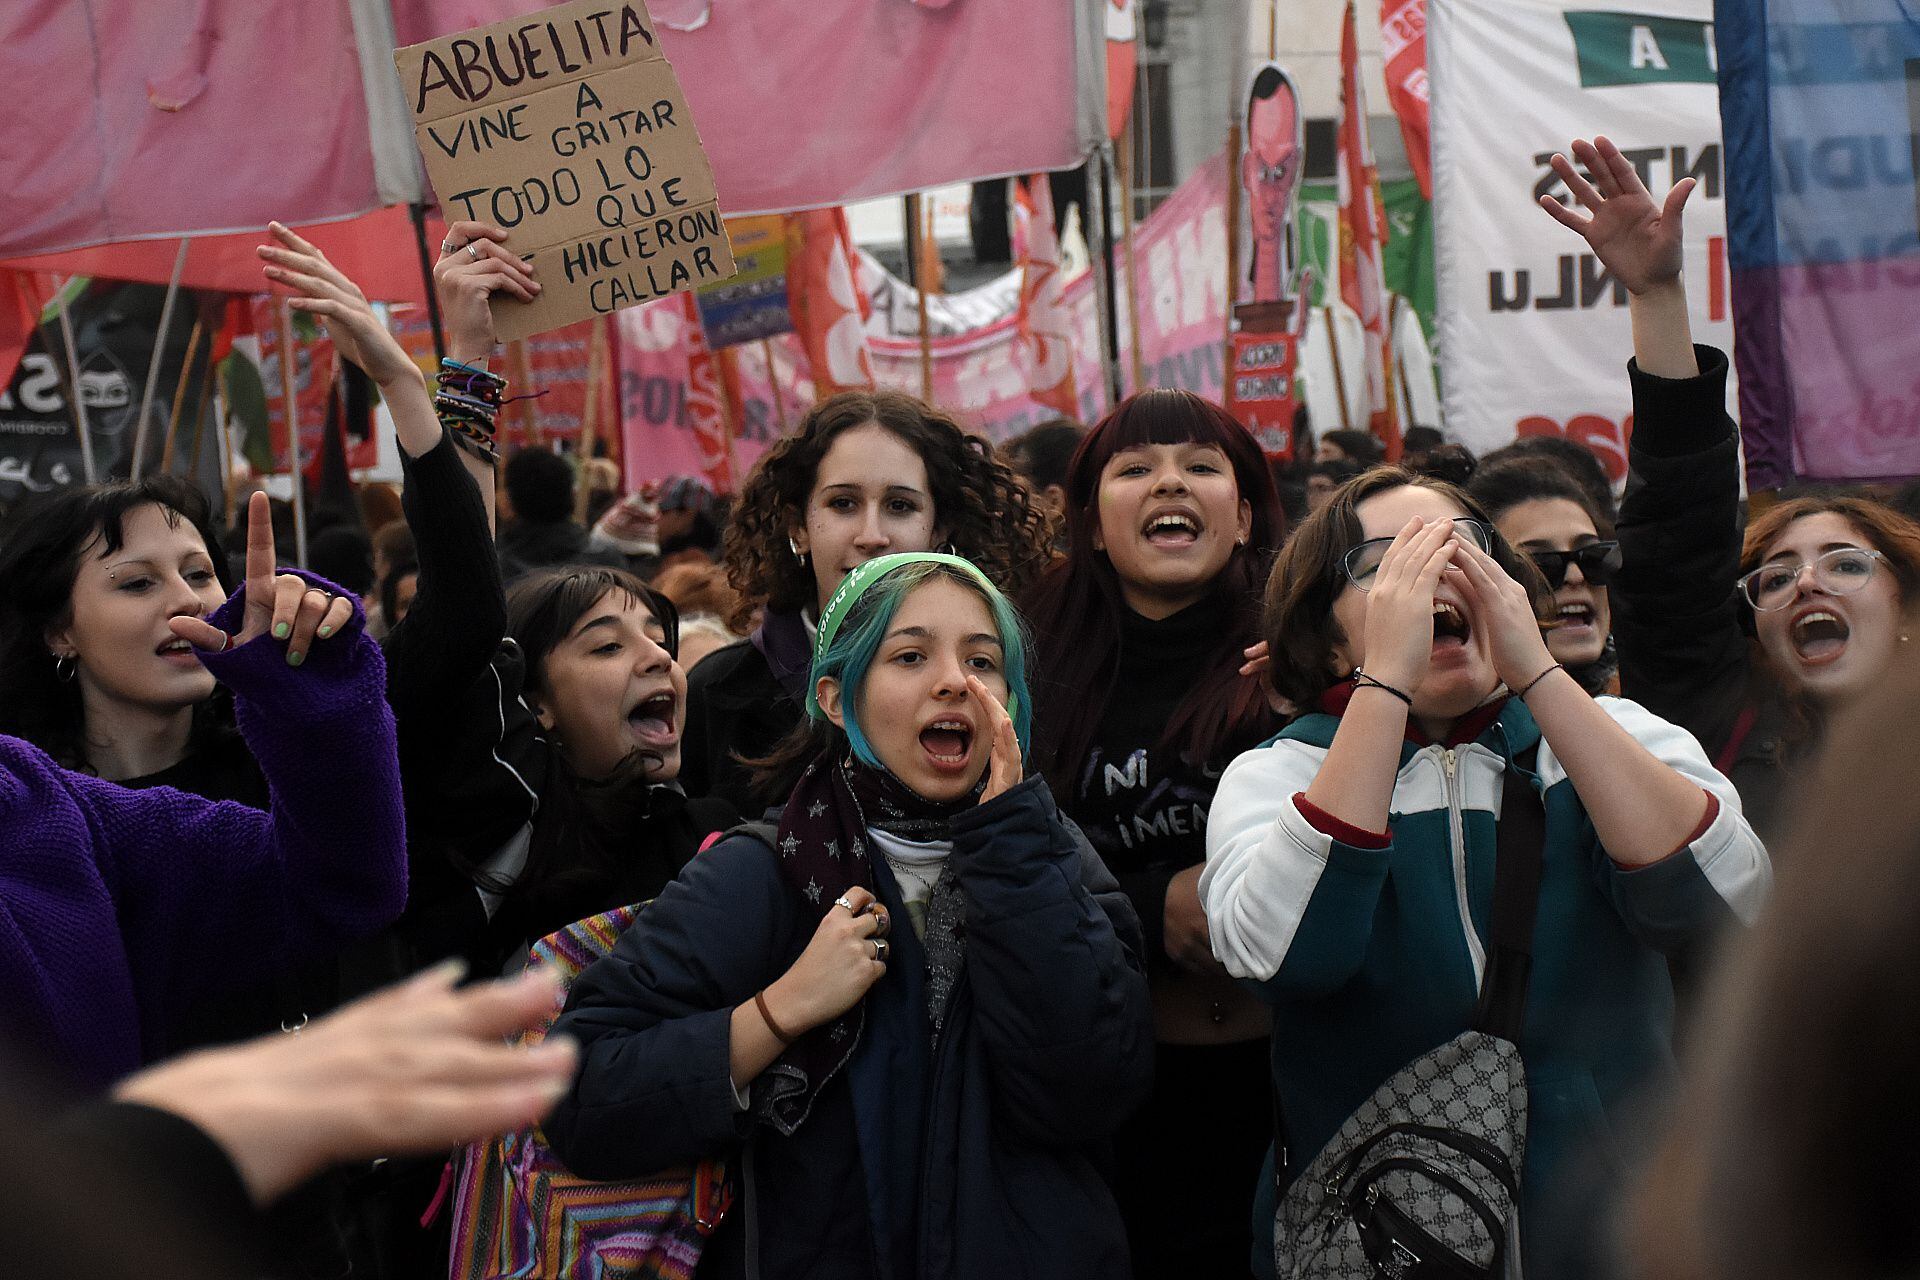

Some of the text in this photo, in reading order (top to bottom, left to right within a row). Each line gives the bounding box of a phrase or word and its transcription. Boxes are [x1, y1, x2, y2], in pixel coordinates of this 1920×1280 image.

[416, 4, 653, 114] ABUELITA
[427, 81, 603, 159] VINE A
[551, 100, 678, 157] GRITAR
[449, 167, 581, 228] TODO
[596, 177, 688, 228] QUE
[562, 210, 719, 284] HICIERON
[589, 246, 719, 313] CALLAR
